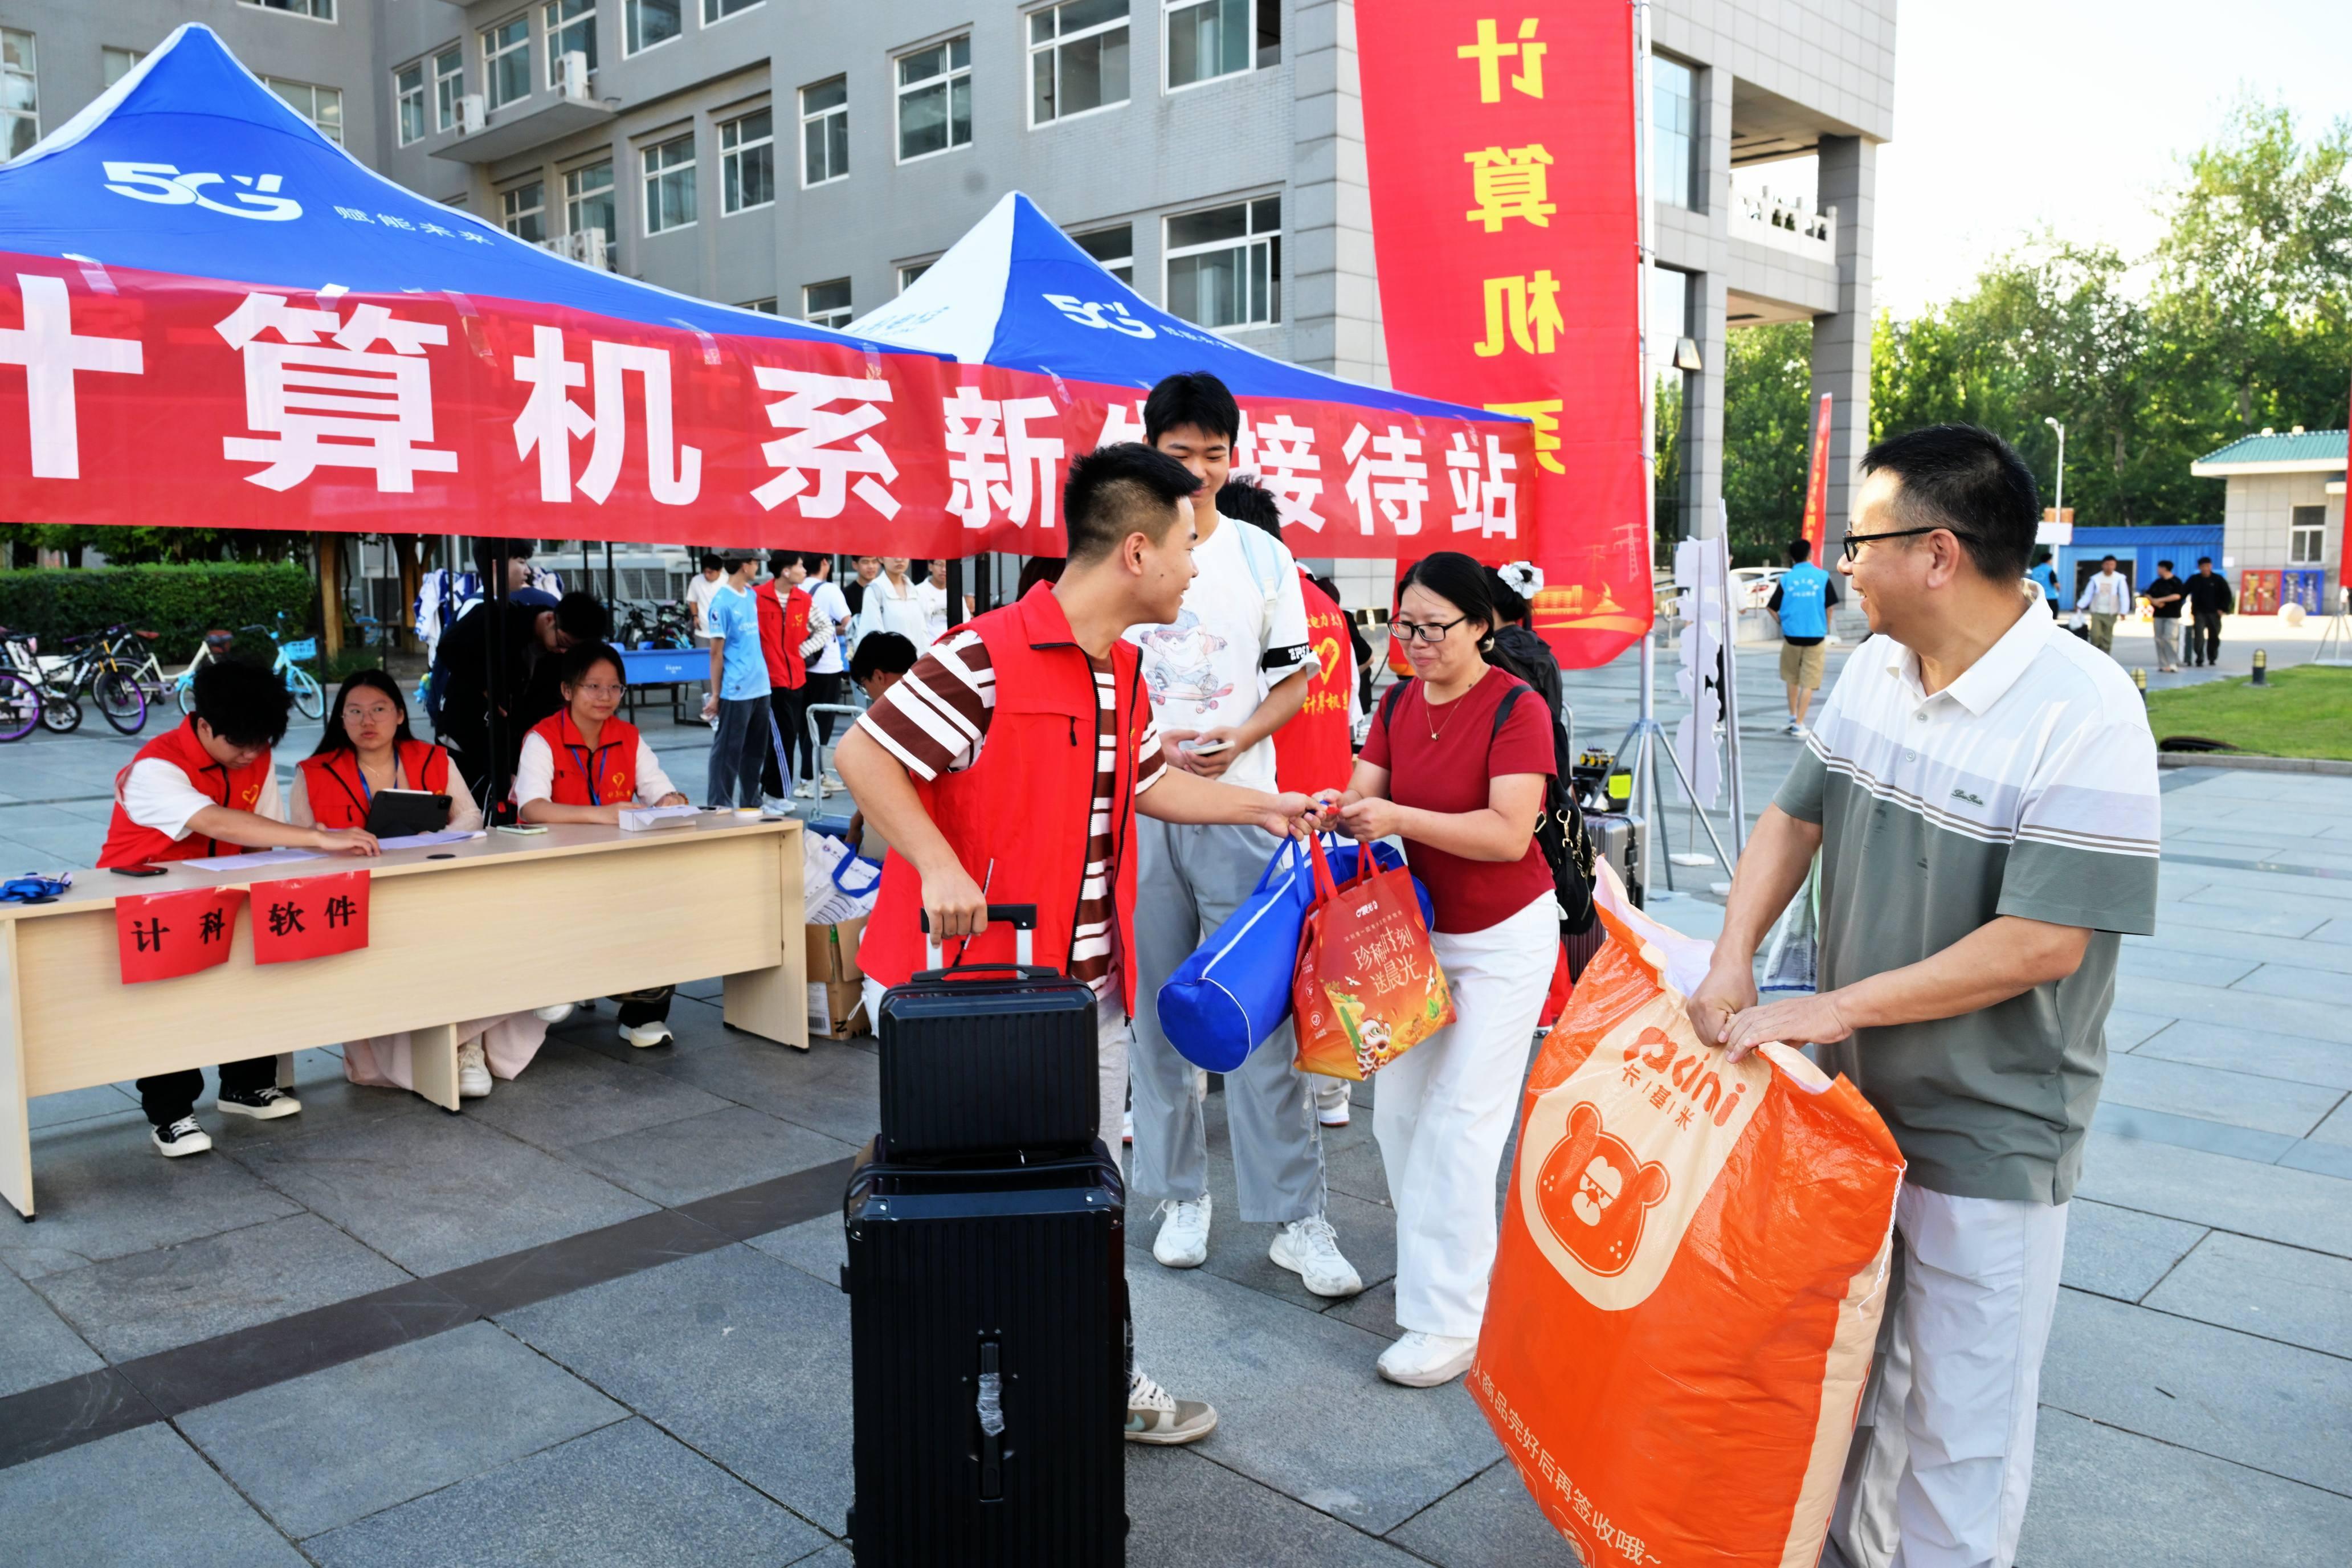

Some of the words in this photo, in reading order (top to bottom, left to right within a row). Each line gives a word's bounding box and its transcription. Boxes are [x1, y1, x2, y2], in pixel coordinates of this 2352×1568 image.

[130, 907, 226, 953] 计科
[268, 895, 357, 937] 软件
[1351, 924, 1415, 971] 珍稀时刻
[1369, 954, 1422, 997] 送晨光
[1472, 1349, 1661, 1566] 认商品完好后再签收哦~
